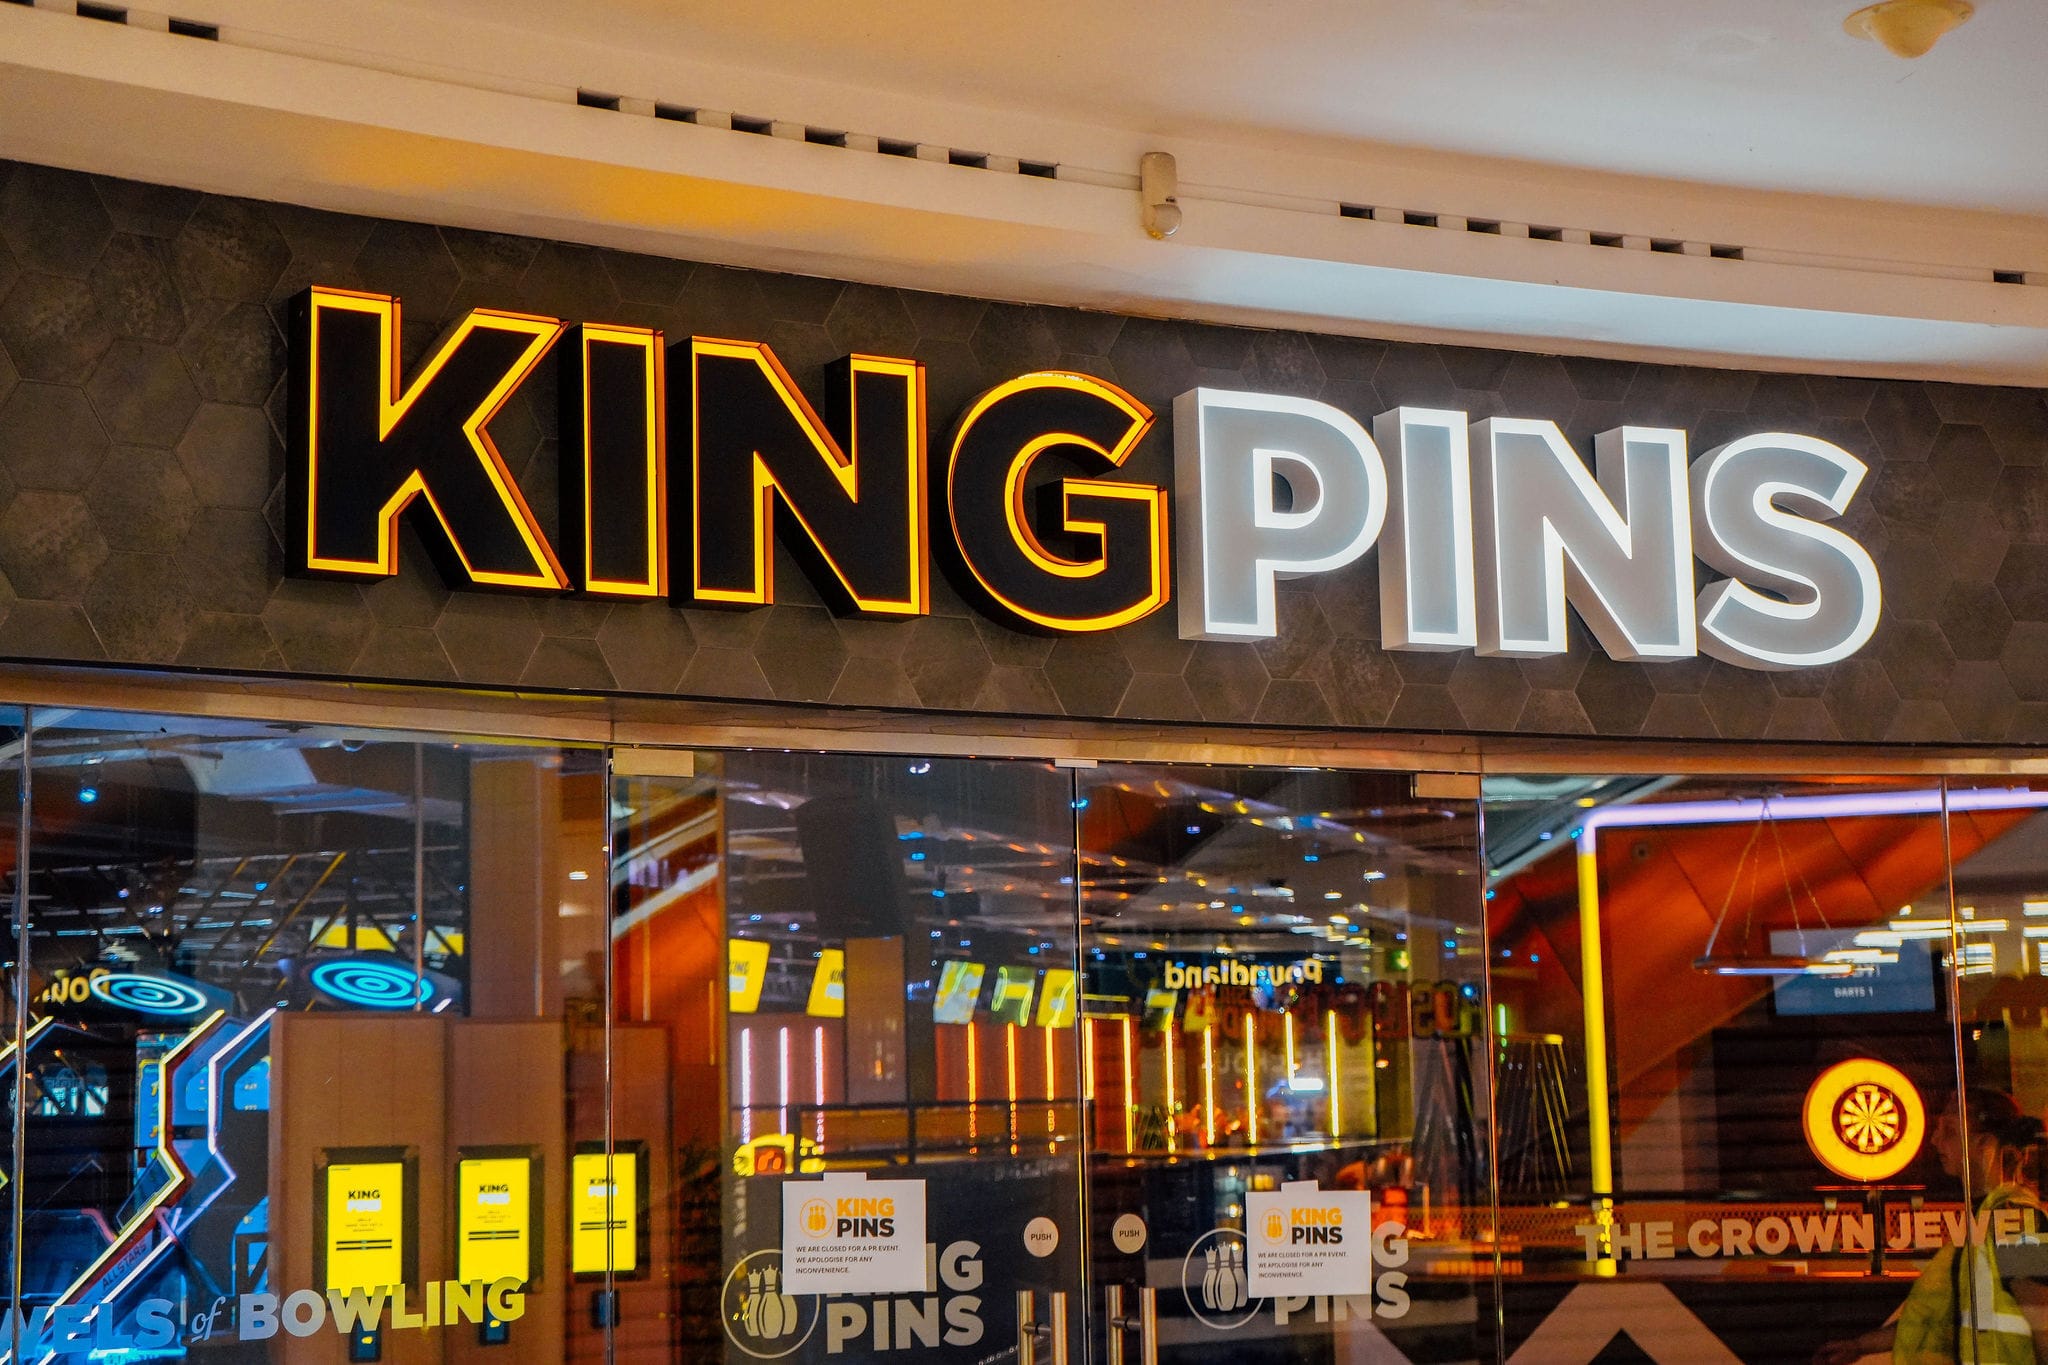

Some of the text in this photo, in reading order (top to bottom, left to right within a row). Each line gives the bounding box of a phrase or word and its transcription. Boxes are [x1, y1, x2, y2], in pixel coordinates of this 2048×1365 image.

[347, 1189, 381, 1200] KING
[836, 1197, 895, 1217] KING
[1291, 1207, 1342, 1226] KING
[836, 1218, 895, 1238] PINS
[1030, 1233, 1052, 1241] PUSH
[1119, 1229, 1140, 1238] PUSH
[1291, 1226, 1343, 1245] PINS
[1575, 1221, 1676, 1262] THE
[1687, 1213, 1875, 1258] CROWN
[102, 1242, 147, 1291] ALLSTARS
[191, 1296, 226, 1344] of
[239, 1275, 525, 1341] BOWLING
[826, 1294, 984, 1354] PINS
